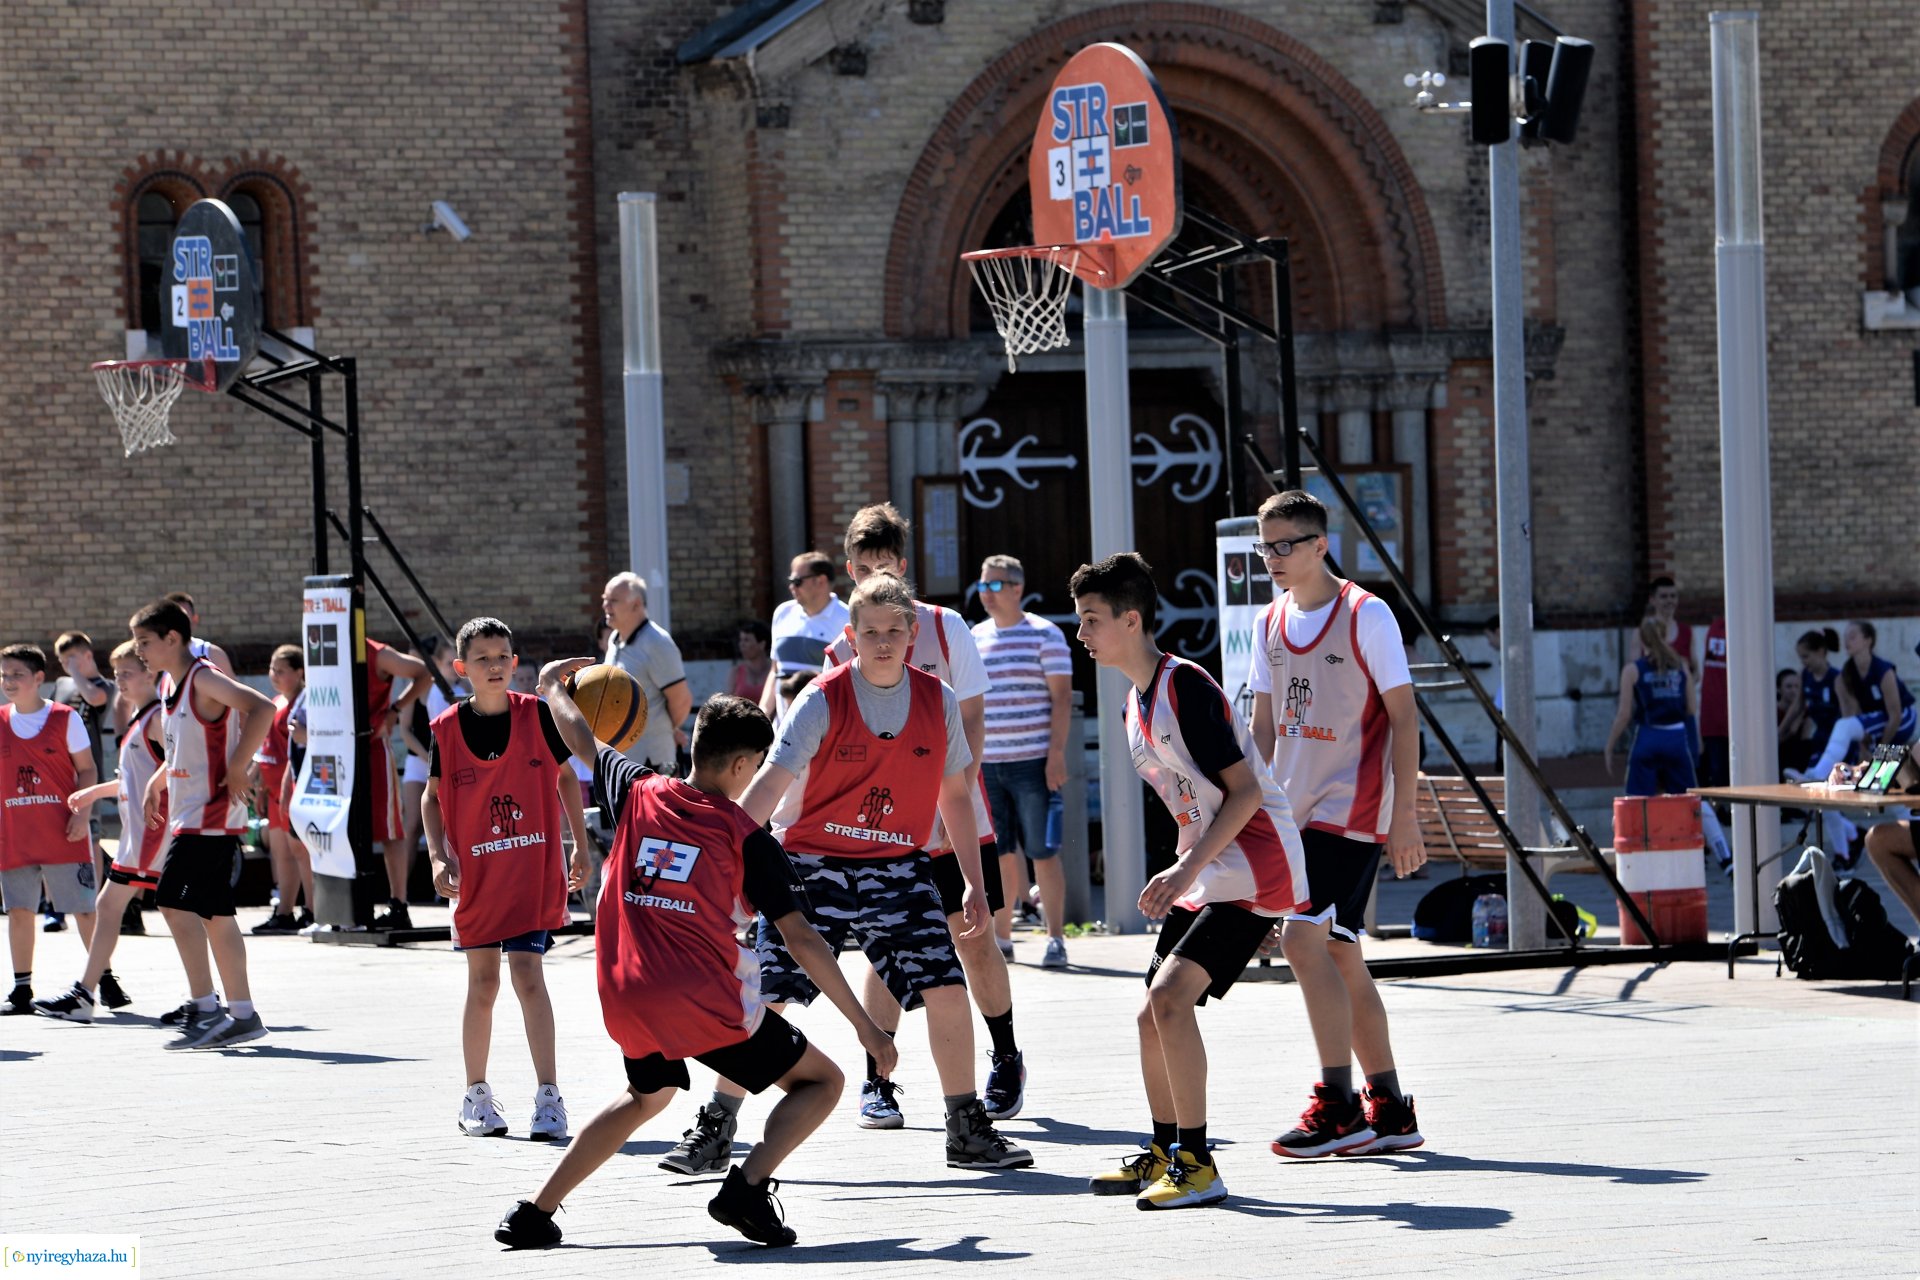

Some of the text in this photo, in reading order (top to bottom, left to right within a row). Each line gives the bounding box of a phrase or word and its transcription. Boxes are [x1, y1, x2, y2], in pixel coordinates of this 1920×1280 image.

[1051, 83, 1109, 142] STR
[1055, 160, 1065, 187] 3
[1073, 183, 1151, 243] BALL
[173, 236, 213, 282] STR
[177, 296, 184, 317] 2
[188, 316, 240, 361] BALL
[309, 686, 341, 707] MVM
[824, 822, 915, 847] STREETBALL
